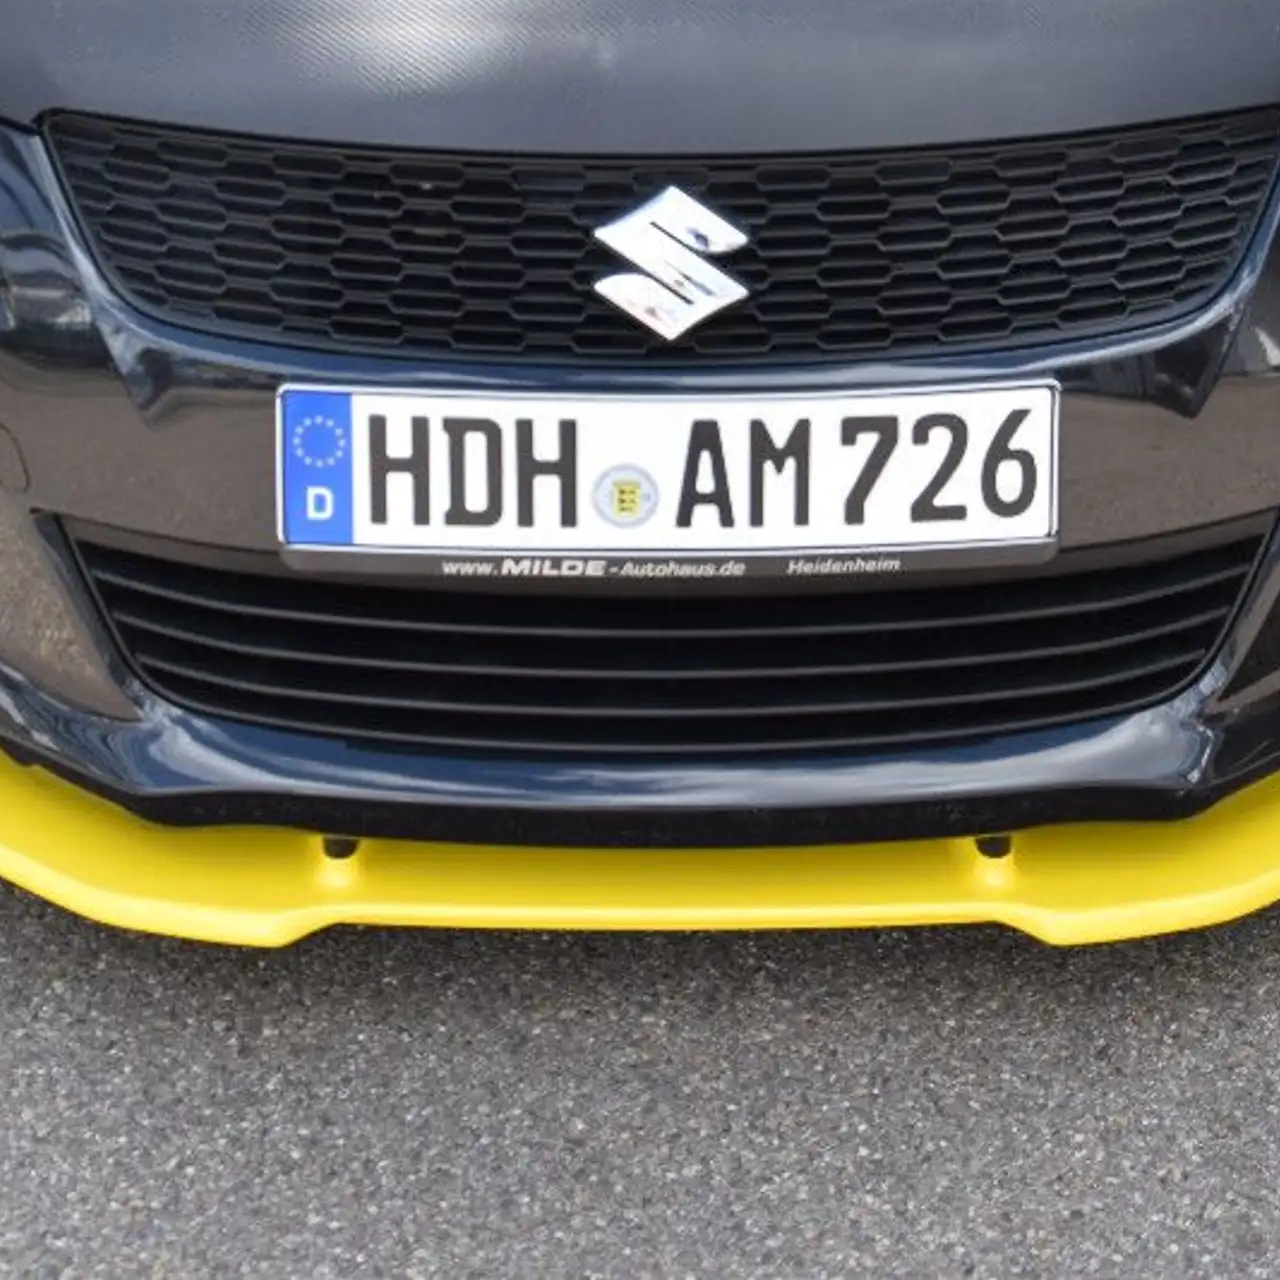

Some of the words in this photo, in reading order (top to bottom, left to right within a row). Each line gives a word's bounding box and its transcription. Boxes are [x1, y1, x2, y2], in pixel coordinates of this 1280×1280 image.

[369, 414, 578, 528] HDH
[676, 417, 811, 528] AM
[841, 409, 1038, 525] 726
[306, 487, 333, 520] D
[785, 556, 902, 575] Heidenheim
